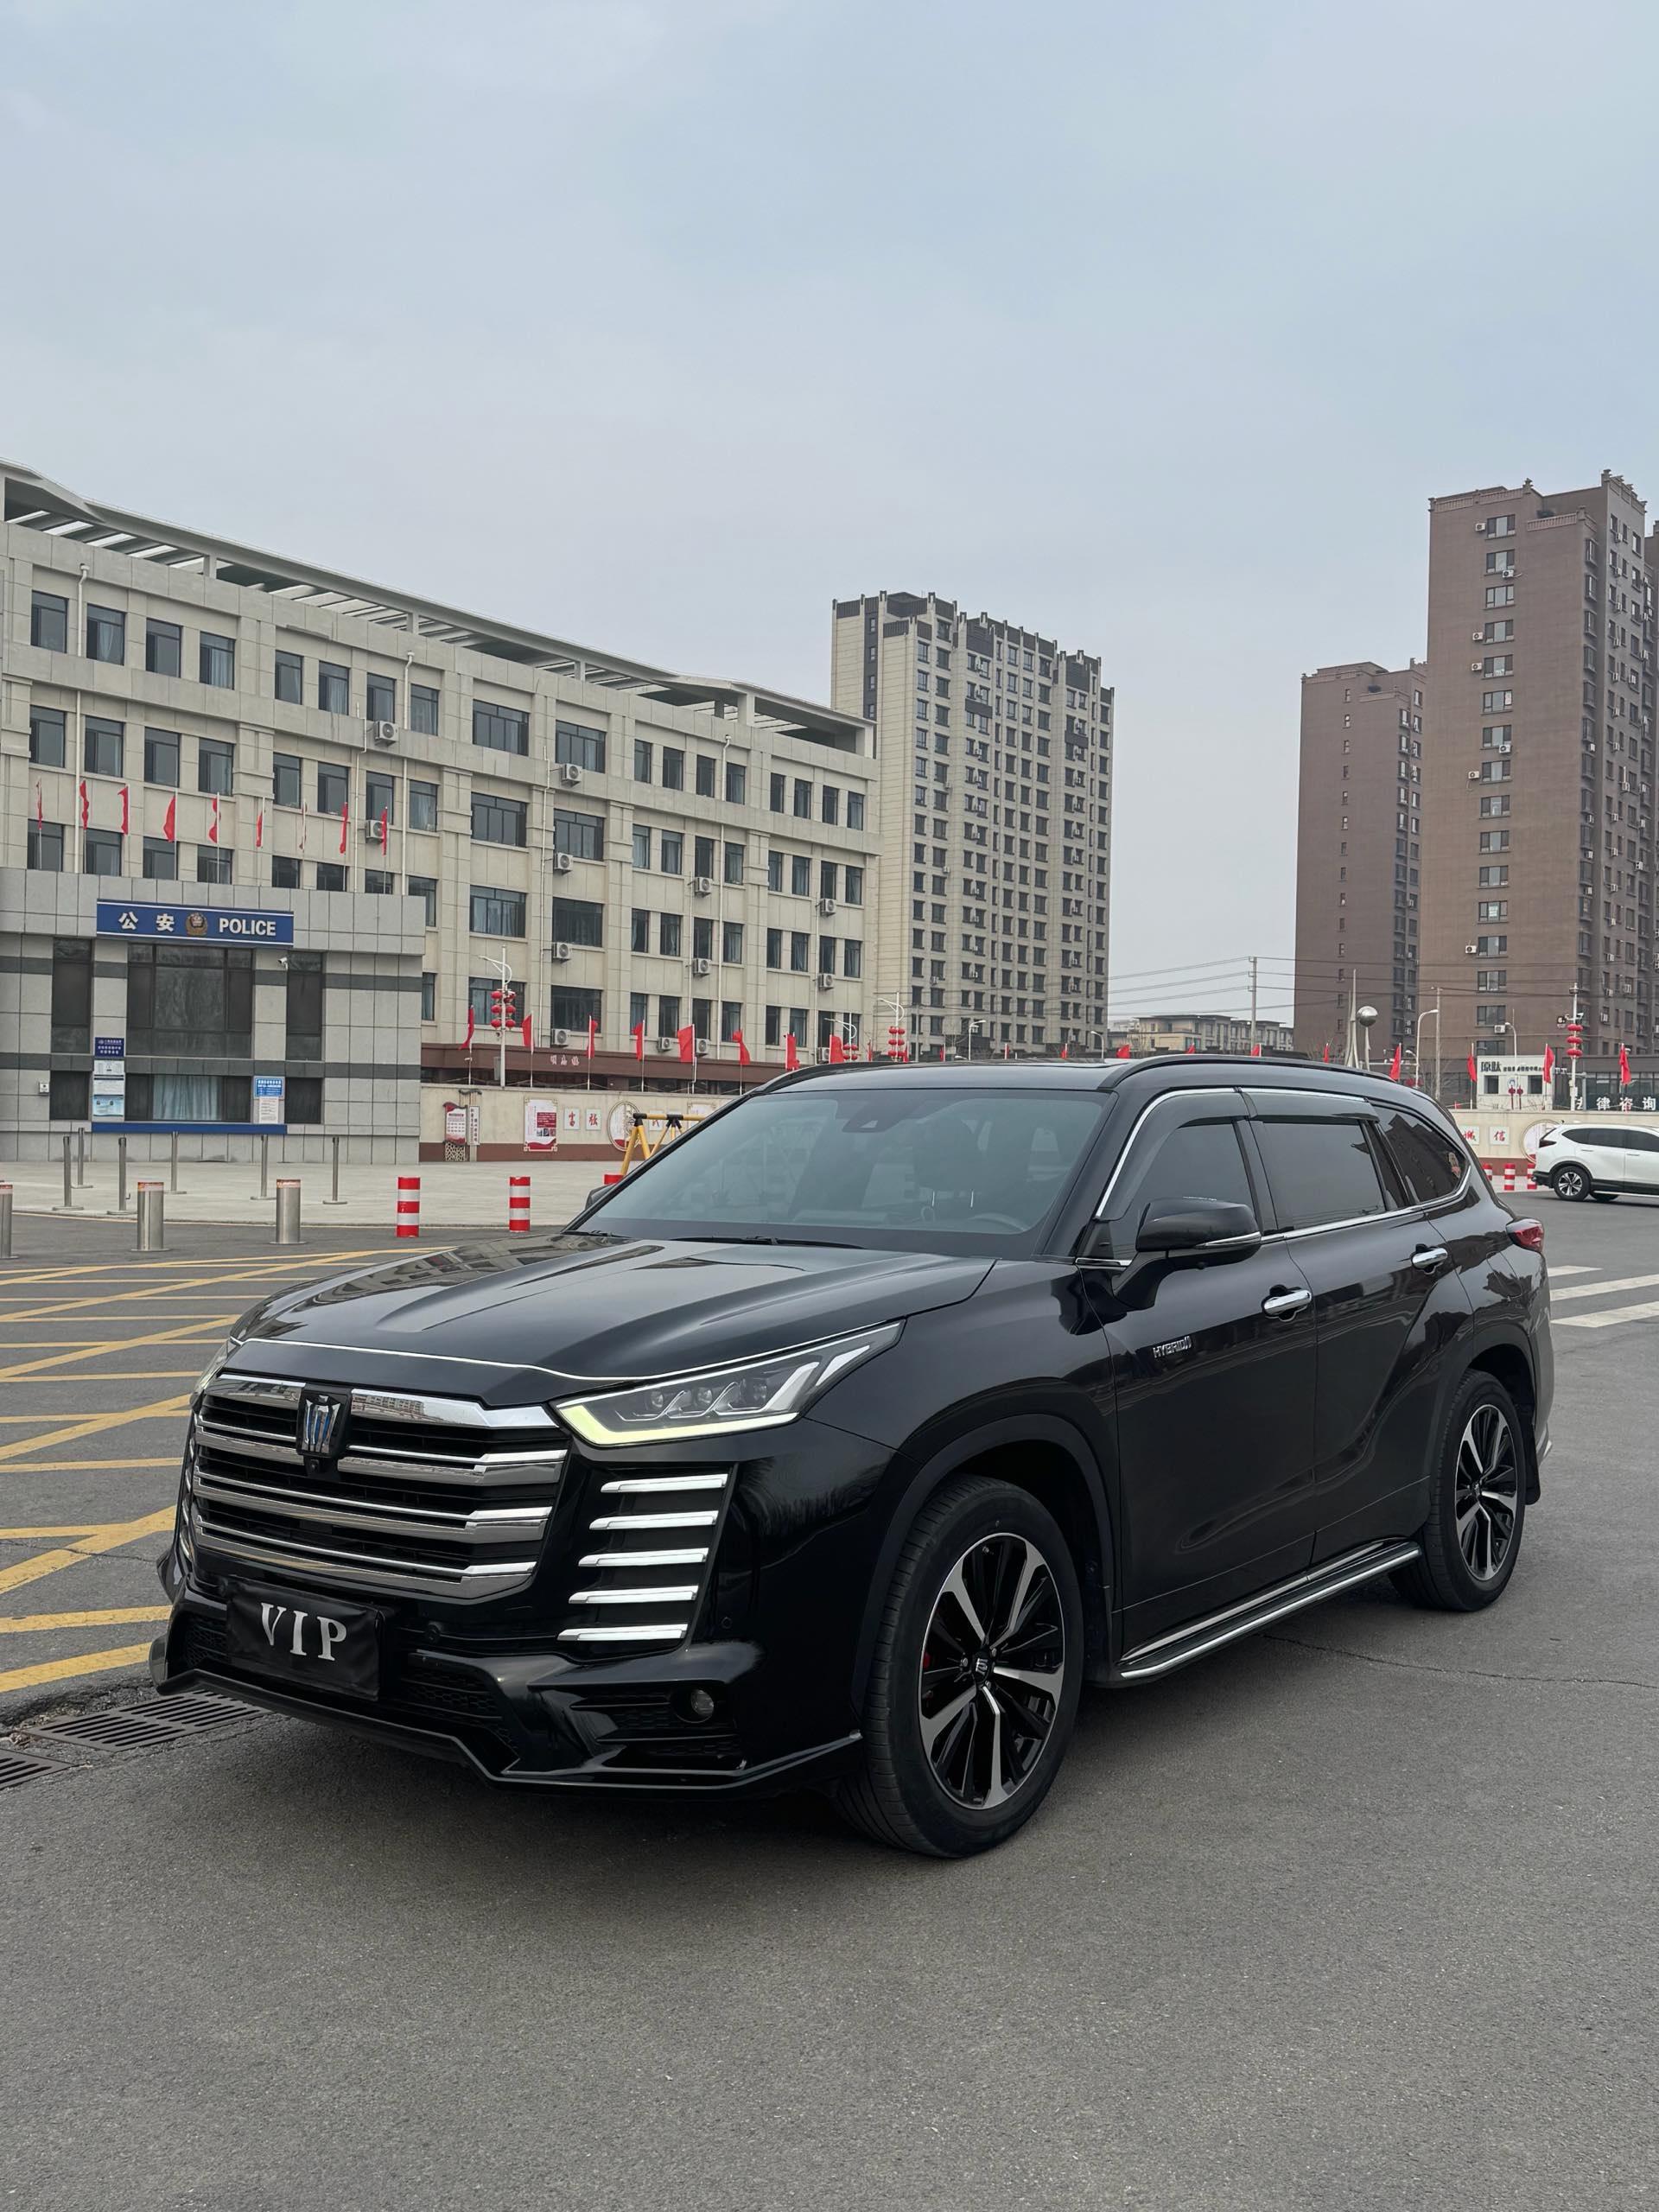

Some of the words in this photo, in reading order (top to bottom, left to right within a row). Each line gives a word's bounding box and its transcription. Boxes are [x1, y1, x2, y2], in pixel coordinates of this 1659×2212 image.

[118, 912, 175, 932] 公安
[219, 918, 276, 937] POLICE
[261, 1602, 347, 1661] VIP
